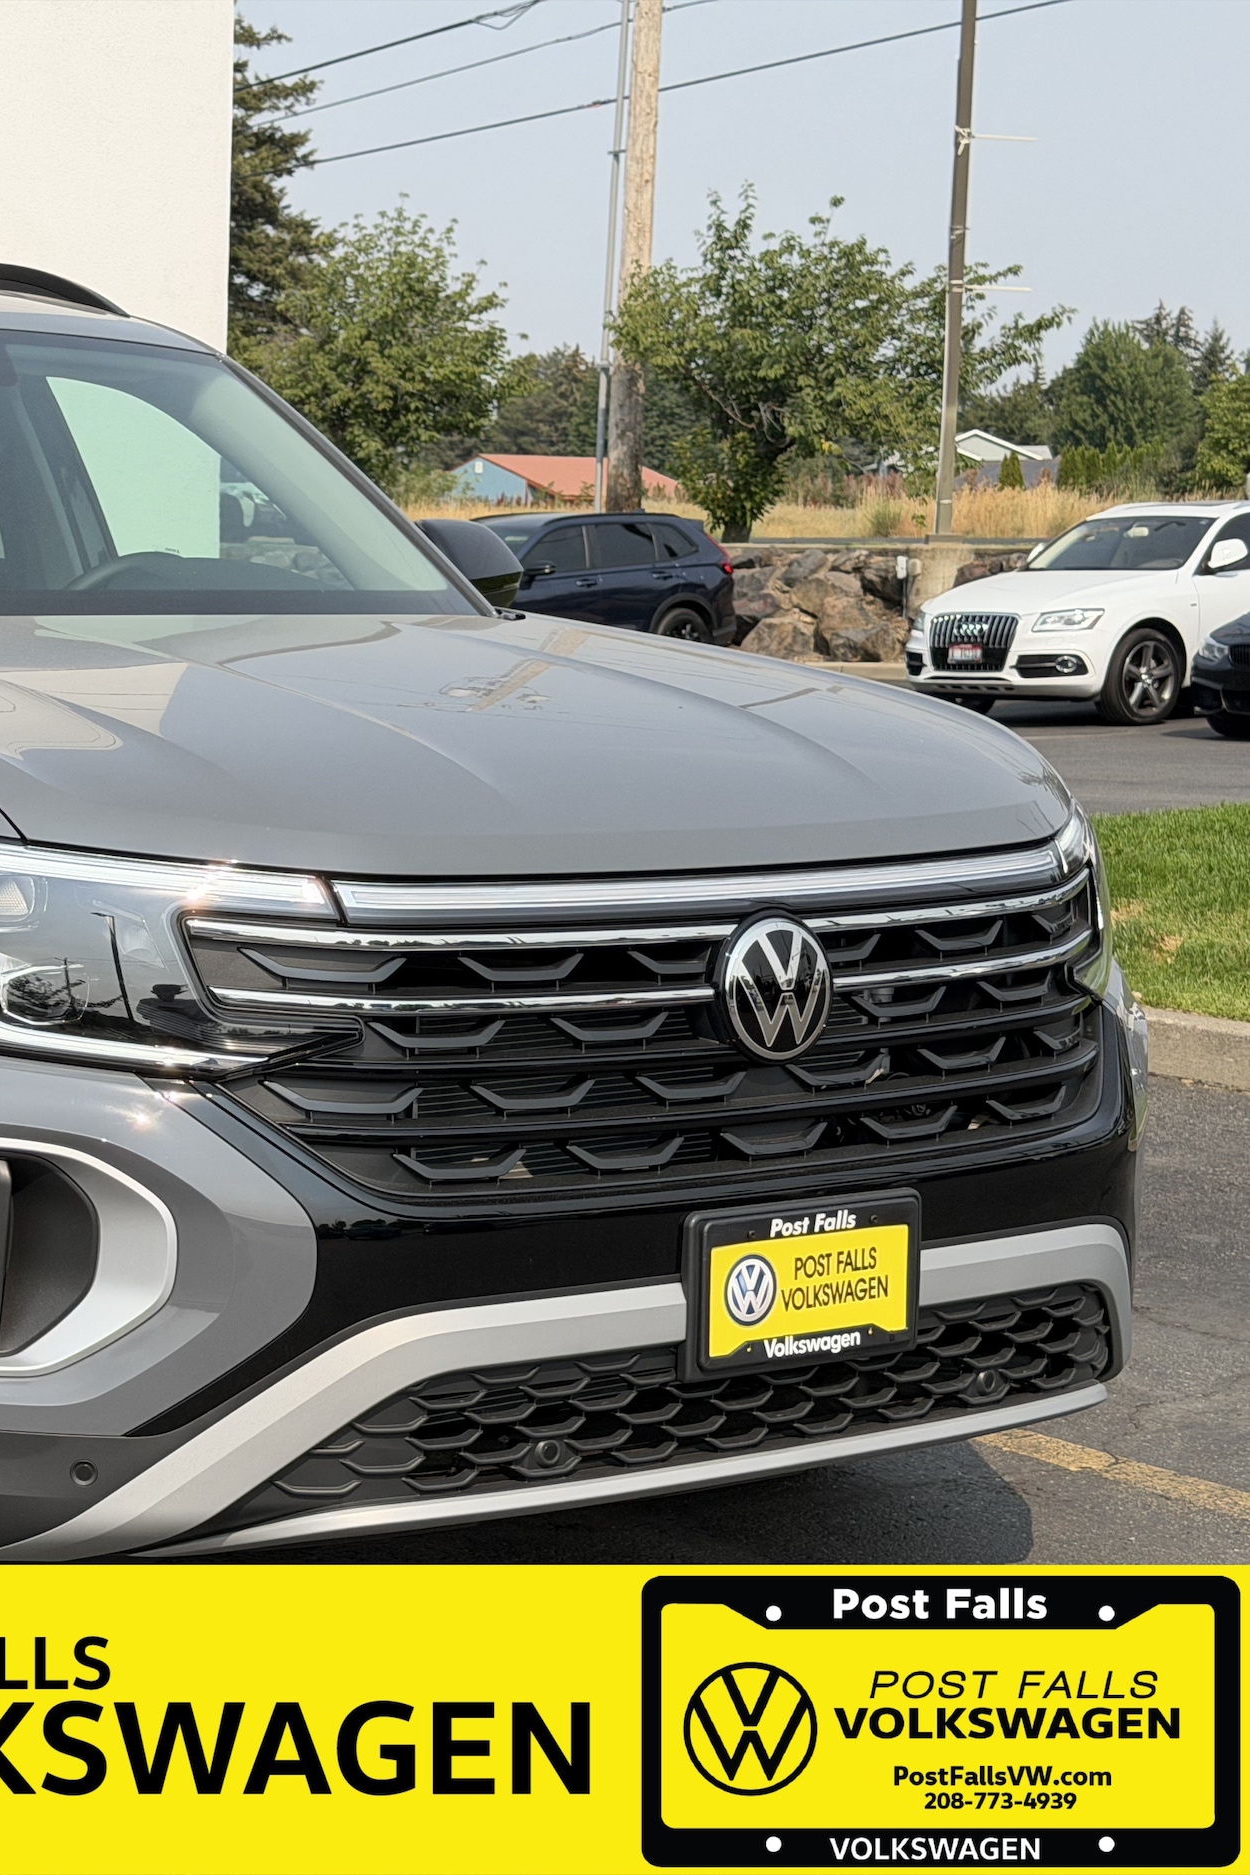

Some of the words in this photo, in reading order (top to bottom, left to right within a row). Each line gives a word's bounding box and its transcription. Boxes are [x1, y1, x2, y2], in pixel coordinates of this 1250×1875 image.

[725, 917, 830, 1060] VW
[770, 1218, 810, 1237] Post
[814, 1209, 857, 1233] Falls
[793, 1252, 832, 1280] POST
[836, 1246, 877, 1274] FALLS
[725, 1254, 777, 1326] VW
[781, 1275, 889, 1312] VOLKSWAGEN
[764, 1331, 861, 1358] Volkswagen
